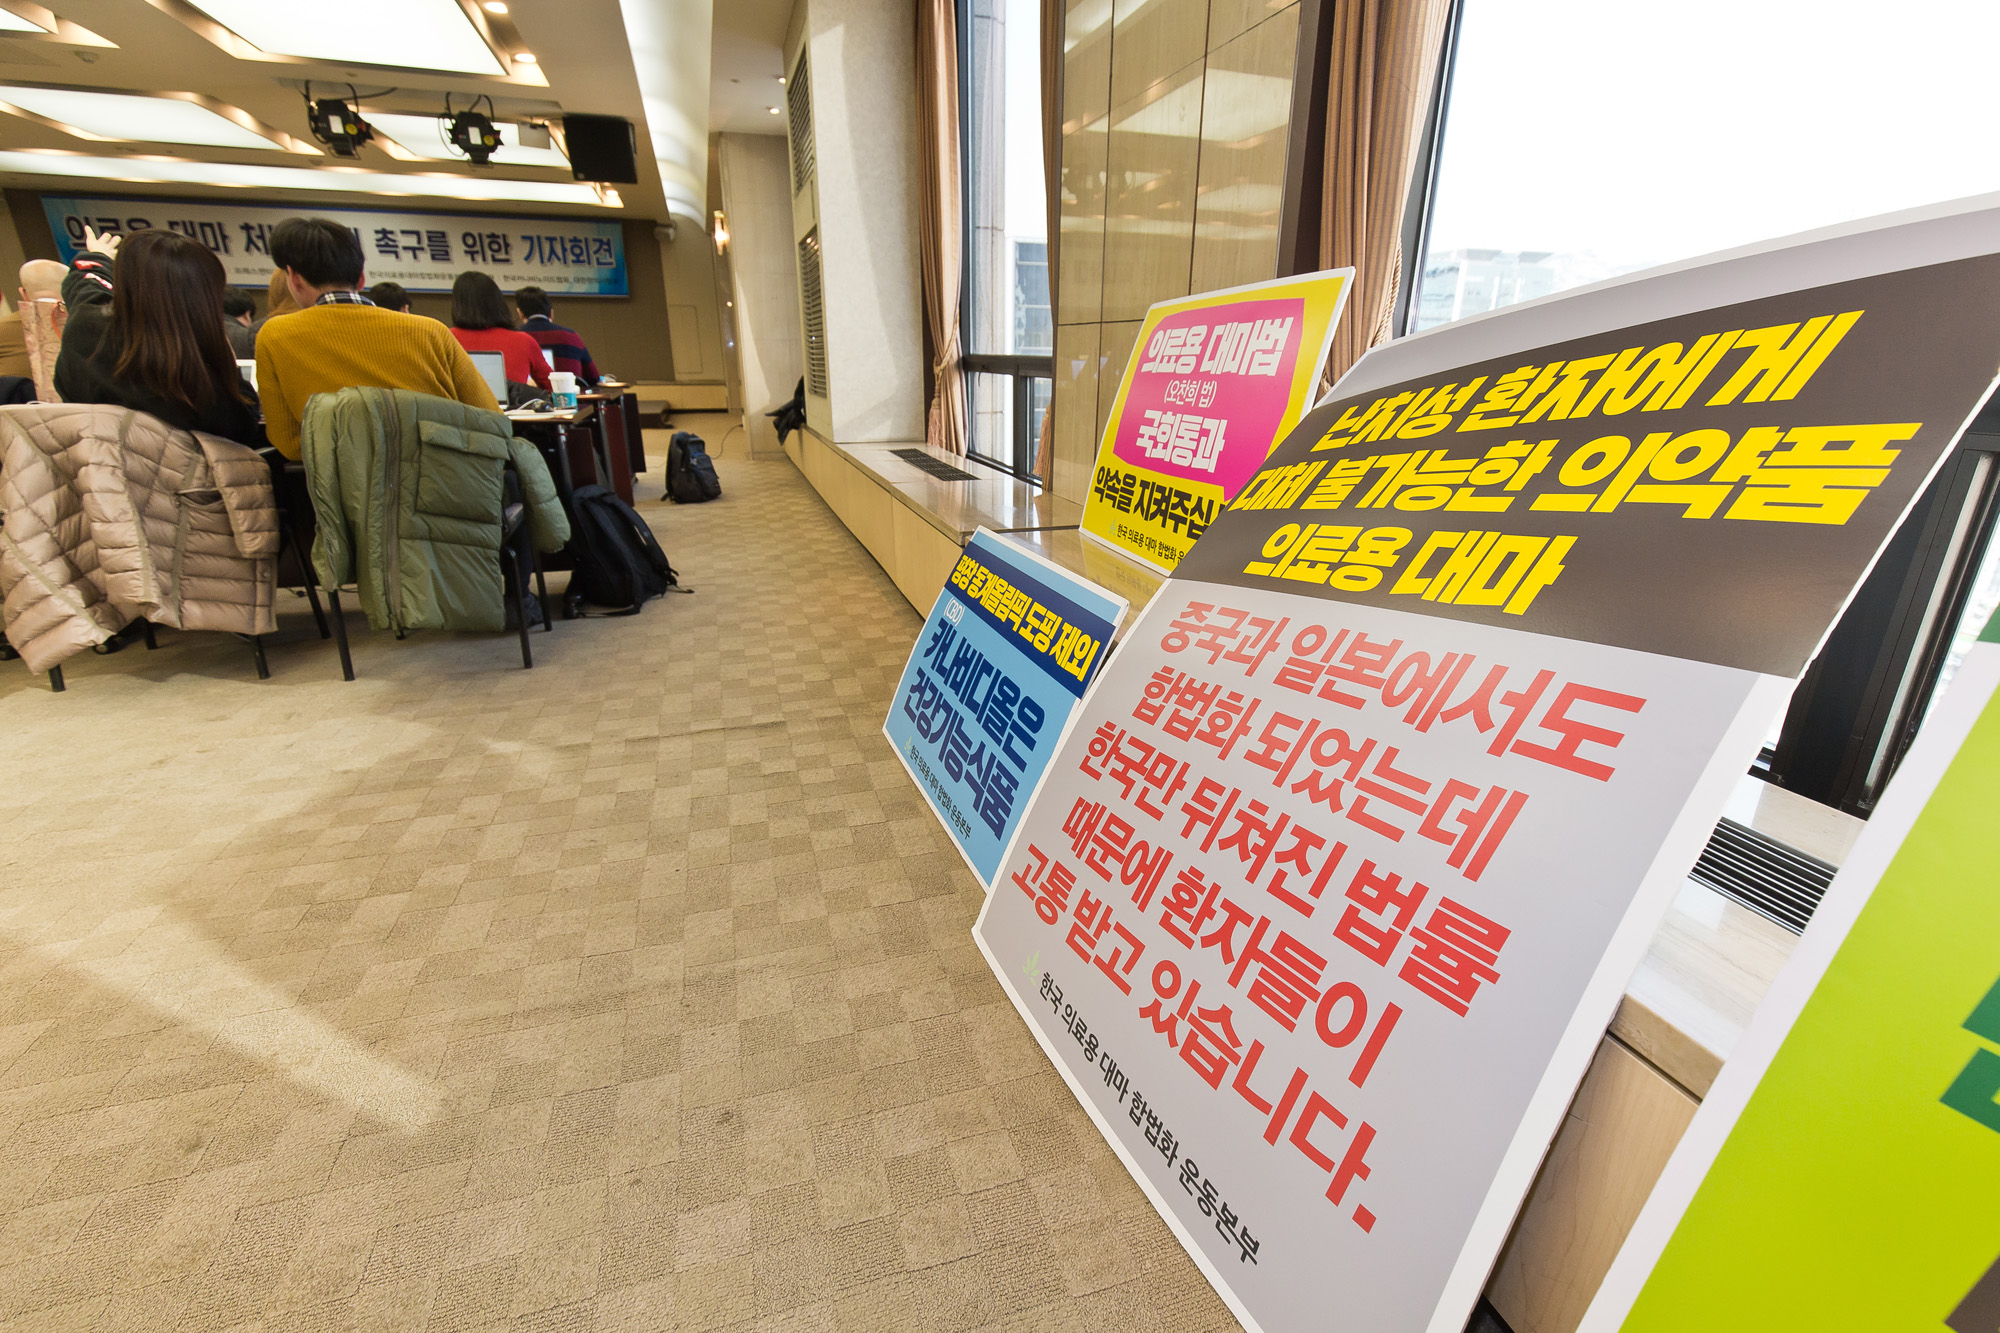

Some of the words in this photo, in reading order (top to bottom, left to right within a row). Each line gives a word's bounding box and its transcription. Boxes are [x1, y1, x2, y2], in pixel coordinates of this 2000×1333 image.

[66, 216, 152, 247] 의료
[374, 227, 451, 262] 촉구를
[461, 232, 510, 263] 위한
[520, 234, 615, 267] 기자회견
[1141, 325, 1208, 374] 의료용
[1199, 317, 1294, 376] 대마법
[1164, 379, 1201, 407] (오찬희
[1198, 380, 1217, 408] 법)
[1310, 376, 1487, 452] 난치성
[1458, 310, 1865, 432] 환자에게
[1136, 409, 1228, 473] 국회통과
[1228, 460, 1329, 511] 대체
[1300, 439, 1561, 513] 불가능한
[1530, 422, 1923, 525] 의약품
[1094, 466, 1137, 514] 약속을
[1133, 479, 1226, 541] 지켜주십
[1117, 523, 1128, 540] 한국
[1129, 529, 1144, 548] 의료용
[1145, 536, 1157, 554] 대마
[1158, 541, 1177, 563] 합법화
[944, 597, 965, 627] (CBD)
[951, 554, 979, 591] 평창
[967, 565, 1032, 632] 동계올림픽
[1018, 601, 1062, 653] 도핑
[1049, 622, 1101, 682] 제외
[1243, 523, 1413, 592] 의료용
[1389, 530, 1578, 616] 대마
[923, 617, 1045, 773] 카나비디올은
[1160, 601, 1291, 676] 중국과
[1273, 625, 1647, 782] 일본에서도
[904, 666, 1019, 841] 건강기능식품
[910, 744, 919, 764] 한국
[919, 756, 931, 781] 의료용
[929, 772, 939, 793] 대마
[938, 784, 952, 814] 합법화
[951, 806, 971, 840] 운동본부
[1132, 665, 1261, 760] 합법화
[1244, 719, 1529, 882] 되었는데
[1079, 721, 1194, 820] 한국만
[1181, 774, 1347, 918] 뒤쳐진
[1333, 859, 1511, 1017] 법률
[1063, 797, 1173, 913] 때문에
[1160, 866, 1403, 1088] 환자들이
[1011, 844, 1076, 925] 고통
[1065, 889, 1145, 996] 받고
[1139, 959, 1377, 1234] 있습니다.
[1040, 972, 1063, 1014] 한국
[1062, 1003, 1099, 1062] 의료용
[1099, 1052, 1129, 1103] 대마
[1128, 1091, 1179, 1168] 합법화
[1178, 1158, 1260, 1265] 운동본부
